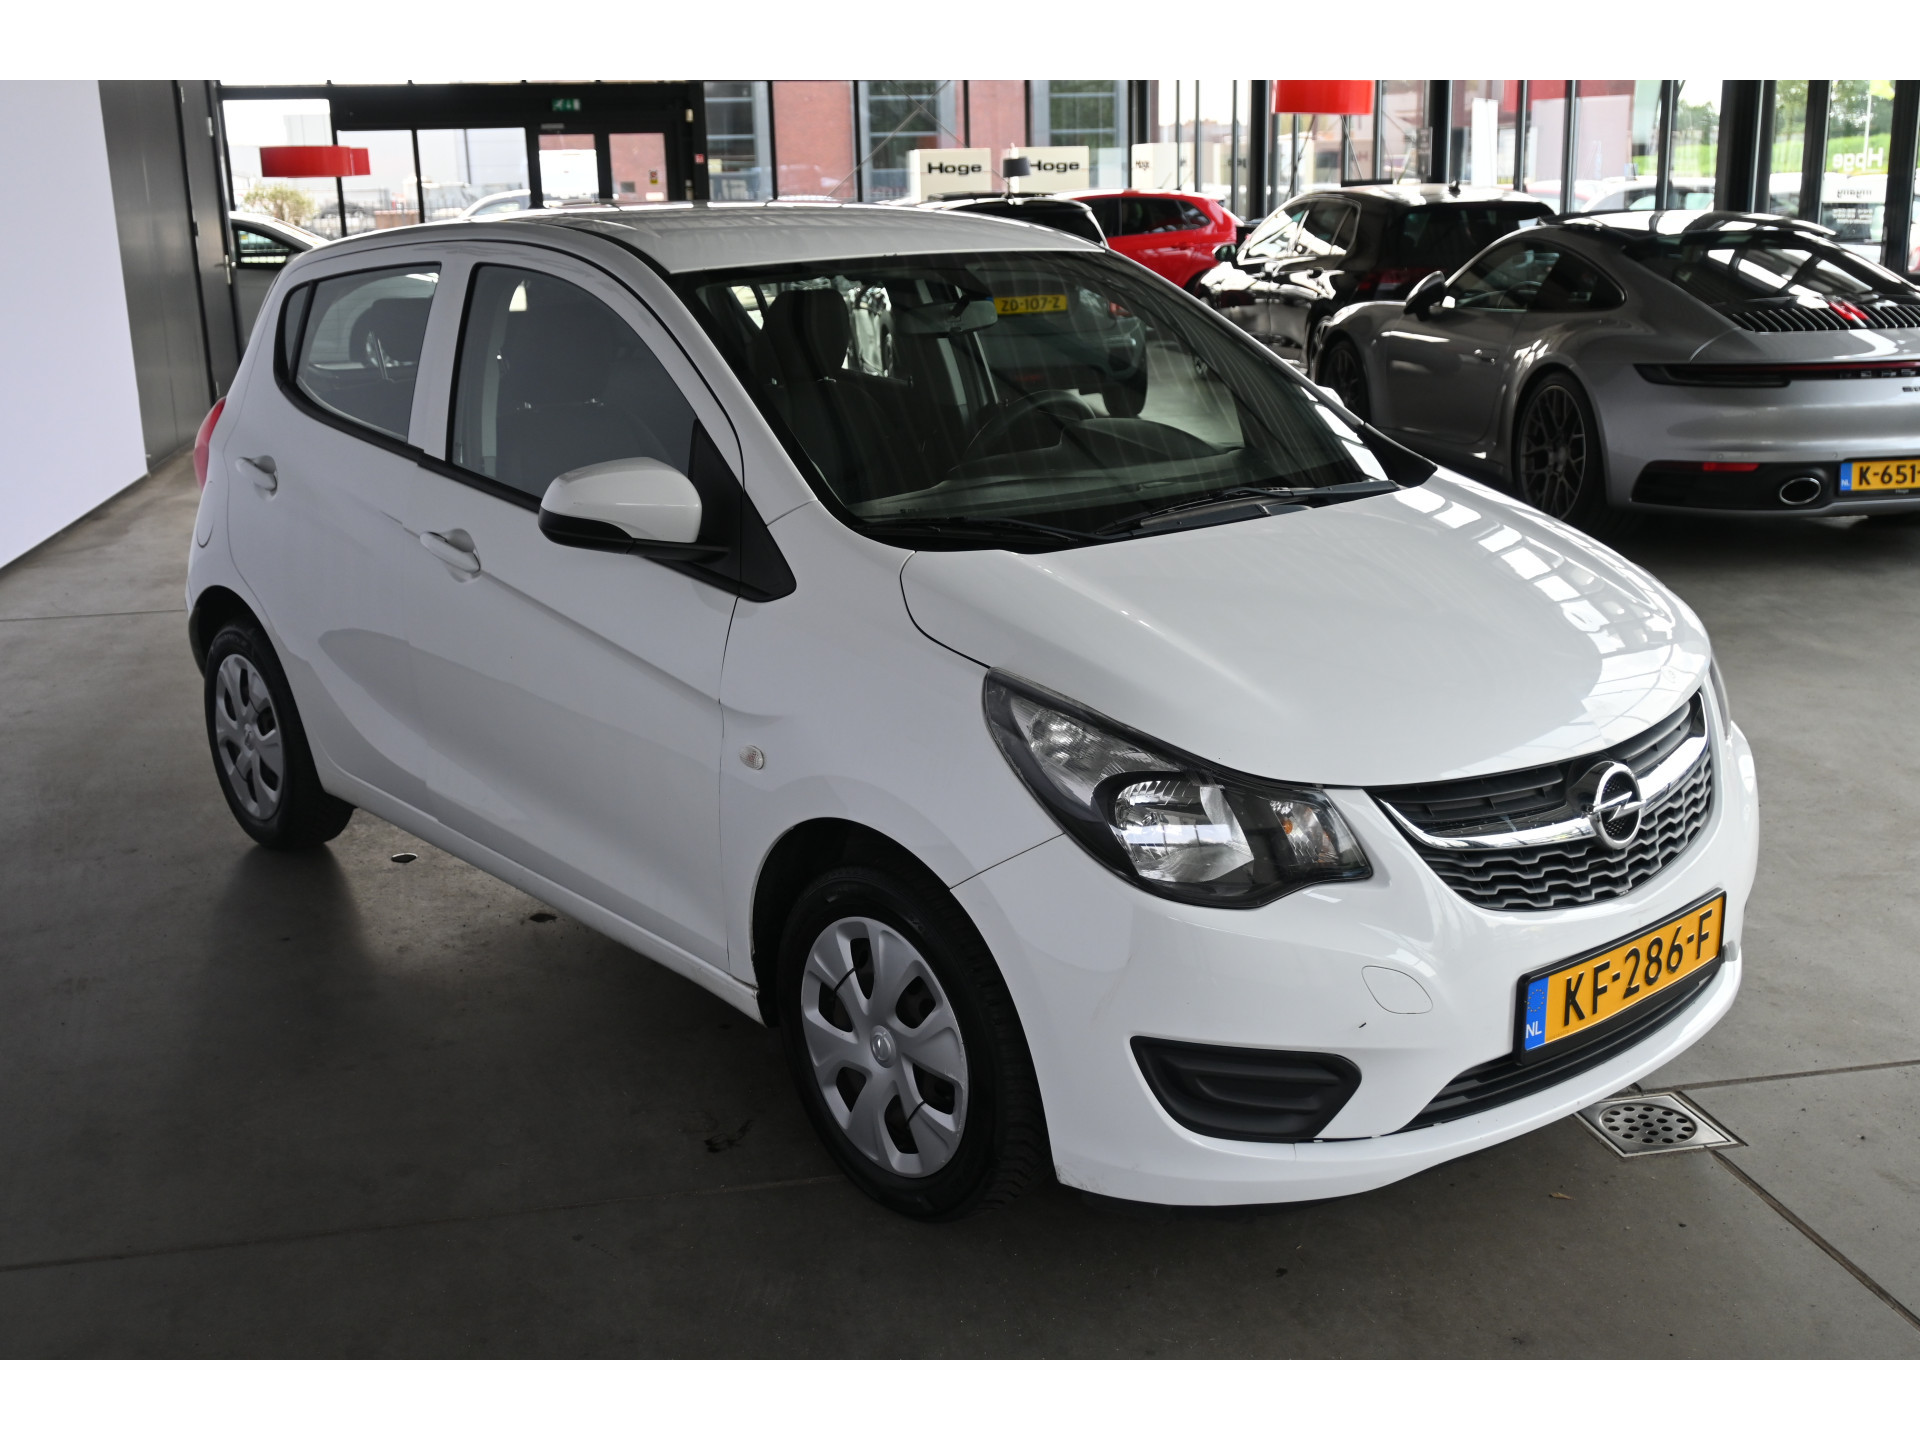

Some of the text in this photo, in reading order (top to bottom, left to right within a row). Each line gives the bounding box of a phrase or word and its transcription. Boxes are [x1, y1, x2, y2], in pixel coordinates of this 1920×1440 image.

[927, 162, 982, 175] Hoge
[1563, 908, 1713, 1027] KF-286-F
[1525, 1020, 1542, 1039] NL
